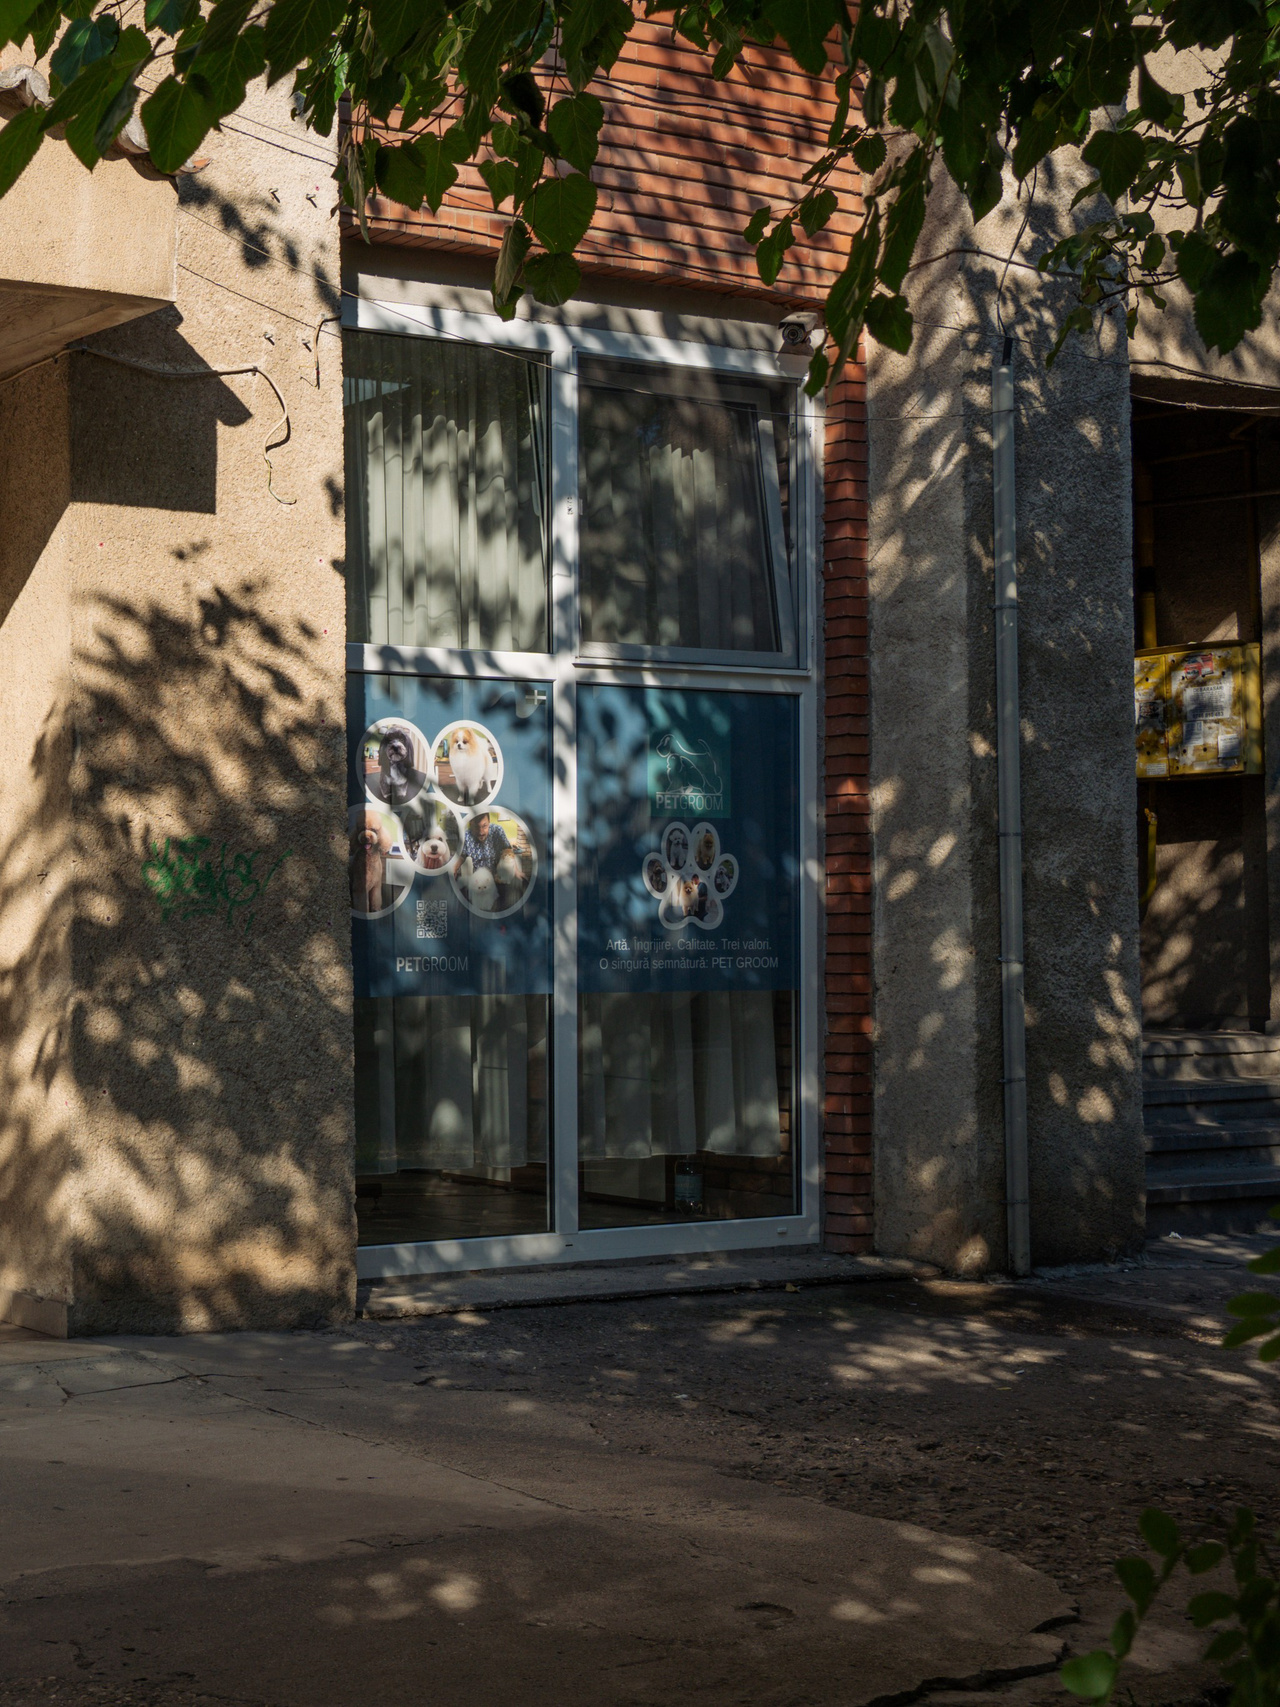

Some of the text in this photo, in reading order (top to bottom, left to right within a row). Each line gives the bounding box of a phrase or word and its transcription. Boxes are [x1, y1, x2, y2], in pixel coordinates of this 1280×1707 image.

[655, 794, 724, 811] PETGROOM
[605, 936, 772, 954] Artă. Îngrijire. Calitate. Trei valori.
[396, 956, 469, 973] PETGROOM
[599, 956, 779, 973] O singură semnătură: PET GROOM
